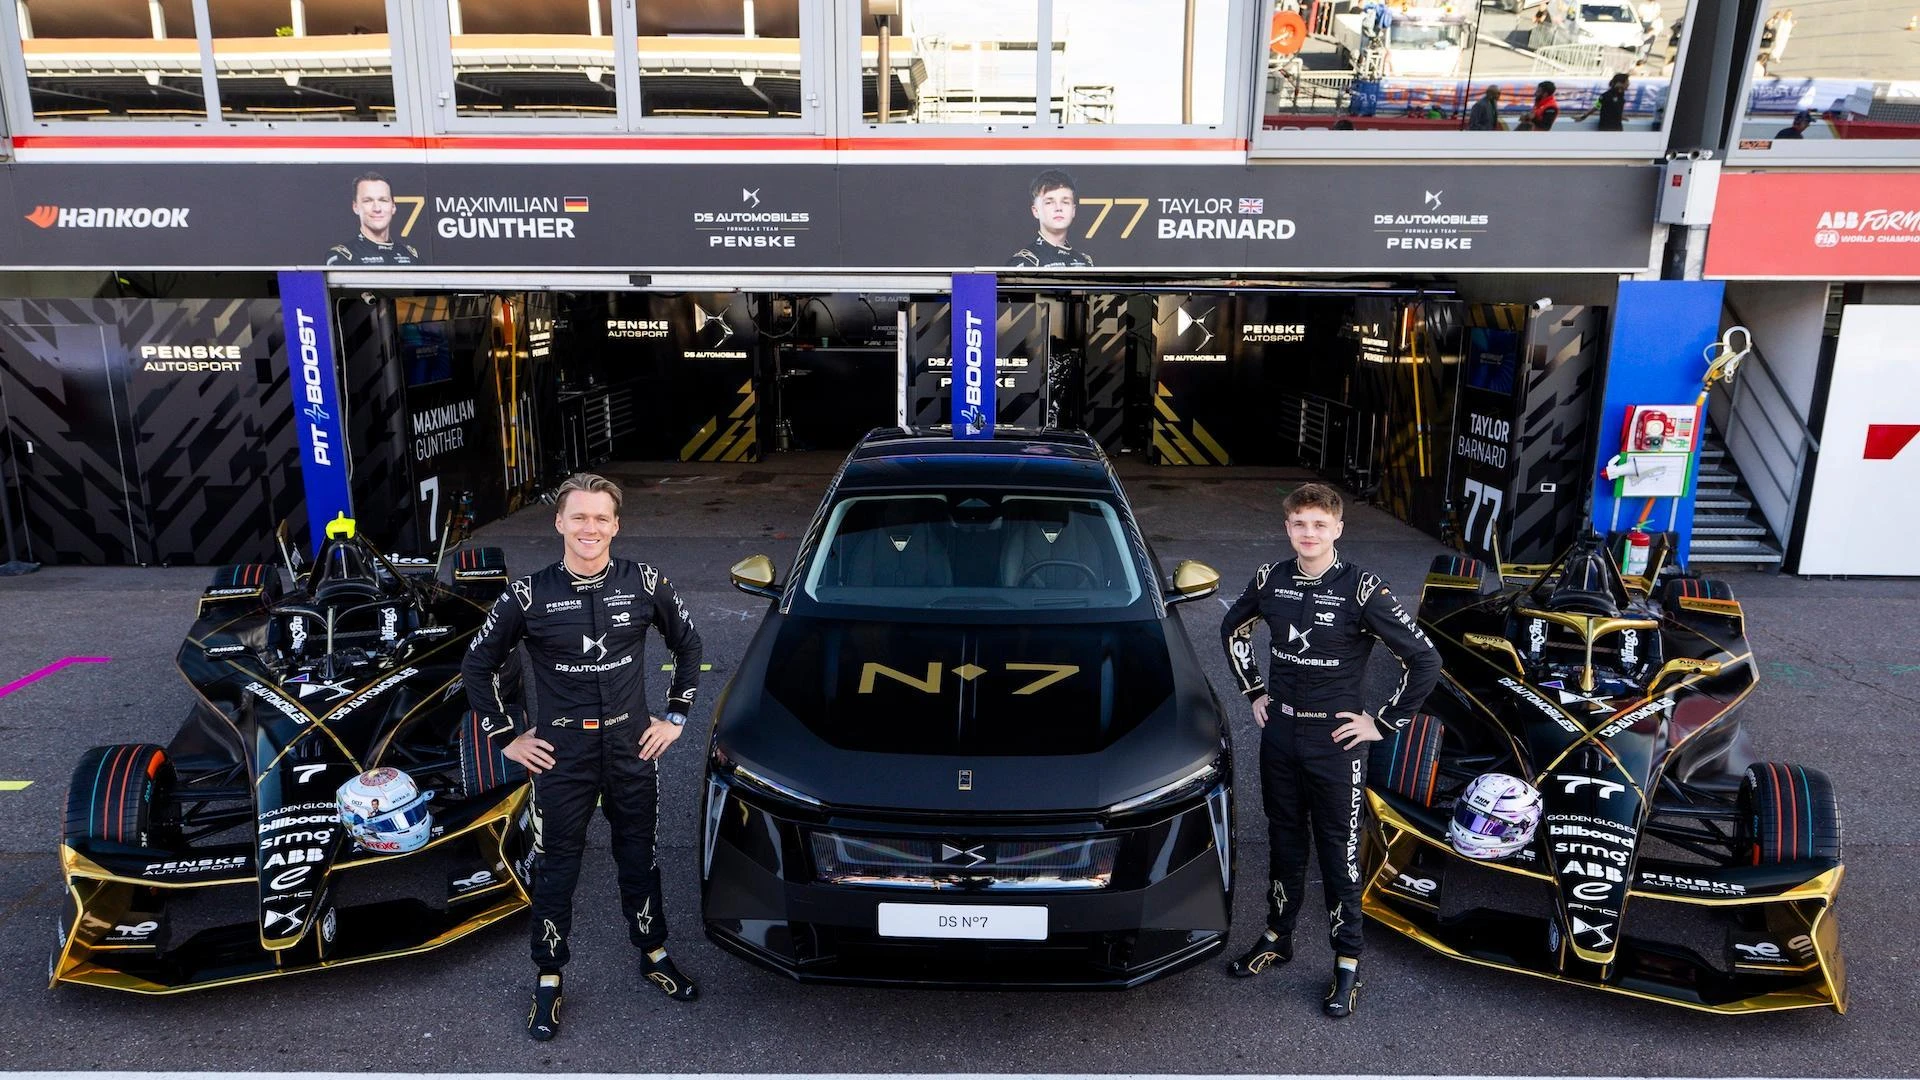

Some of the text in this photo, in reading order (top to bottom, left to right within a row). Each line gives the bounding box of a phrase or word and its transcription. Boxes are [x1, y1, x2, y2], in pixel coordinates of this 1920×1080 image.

[436, 197, 558, 213] MAXIMILIAN
[1158, 198, 1232, 214] TAYLOR
[394, 197, 425, 237] 7
[438, 212, 575, 239] GÜNTHER
[694, 213, 809, 222] DS AUTOMOBILES
[1079, 198, 1149, 239] 77
[1374, 215, 1488, 224] DS AUTOMOBILES
[1816, 212, 1859, 229] ABB
[1158, 219, 1296, 240] BARNARD
[710, 236, 796, 247] PENSKE
[1387, 238, 1472, 249] PENSKE
[1841, 235, 1920, 243] WORLD CHAMPIO
[608, 320, 669, 330] PENSKE
[608, 330, 669, 338] AUTOSPORT
[1243, 324, 1305, 334] PENSKE
[1243, 334, 1305, 342] AUTOSPORT
[141, 346, 241, 359] PENSKE
[296, 308, 324, 405] BOOST
[966, 310, 984, 406] BOOST
[144, 362, 242, 372] AUTOSPORT
[928, 358, 945, 367] DS
[413, 400, 475, 435] MAXIMILIAN
[1471, 413, 1510, 443] TAYLOR
[311, 424, 331, 466] PIT
[416, 427, 464, 461] GÜNTHER
[1458, 436, 1507, 469] BARNARD
[420, 476, 439, 542] 7
[1464, 478, 1503, 551] 77
[577, 581, 604, 593] PMC
[1296, 579, 1323, 587] PMC
[1275, 588, 1304, 598] PENSKE
[546, 600, 582, 609] PENSKE
[556, 655, 633, 673] DS AUTOMOBILES
[1277, 651, 1340, 667] AUTOMOBILES
[329, 667, 420, 721] DS AUTOMOBILES
[246, 682, 310, 725] DS AUTOMOBILES
[1498, 676, 1580, 733] DS AUTOMOBILES
[604, 713, 629, 726] GÜNTHER
[1599, 696, 1676, 738] DS AUTOMOBILES
[293, 764, 327, 783] 7
[1557, 775, 1625, 800] 77
[258, 802, 338, 820] GOLDEN GLOB
[259, 814, 341, 834] billboard
[1346, 759, 1362, 883] DS AUTOMOBILES
[1547, 814, 1637, 836] GOLDEN GLOBES
[260, 828, 335, 850] srmg
[1550, 825, 1634, 849] billboard
[263, 848, 324, 870] ABB
[1555, 842, 1630, 866] srmg
[142, 863, 245, 876] AUTOSPORT
[145, 857, 247, 871] PENSKE
[1562, 860, 1624, 883] ABB
[1642, 873, 1746, 892] PENSKE
[1643, 880, 1747, 896] AUTOSPORT
[1568, 903, 1619, 918] PMC
[938, 916, 957, 928] DS
